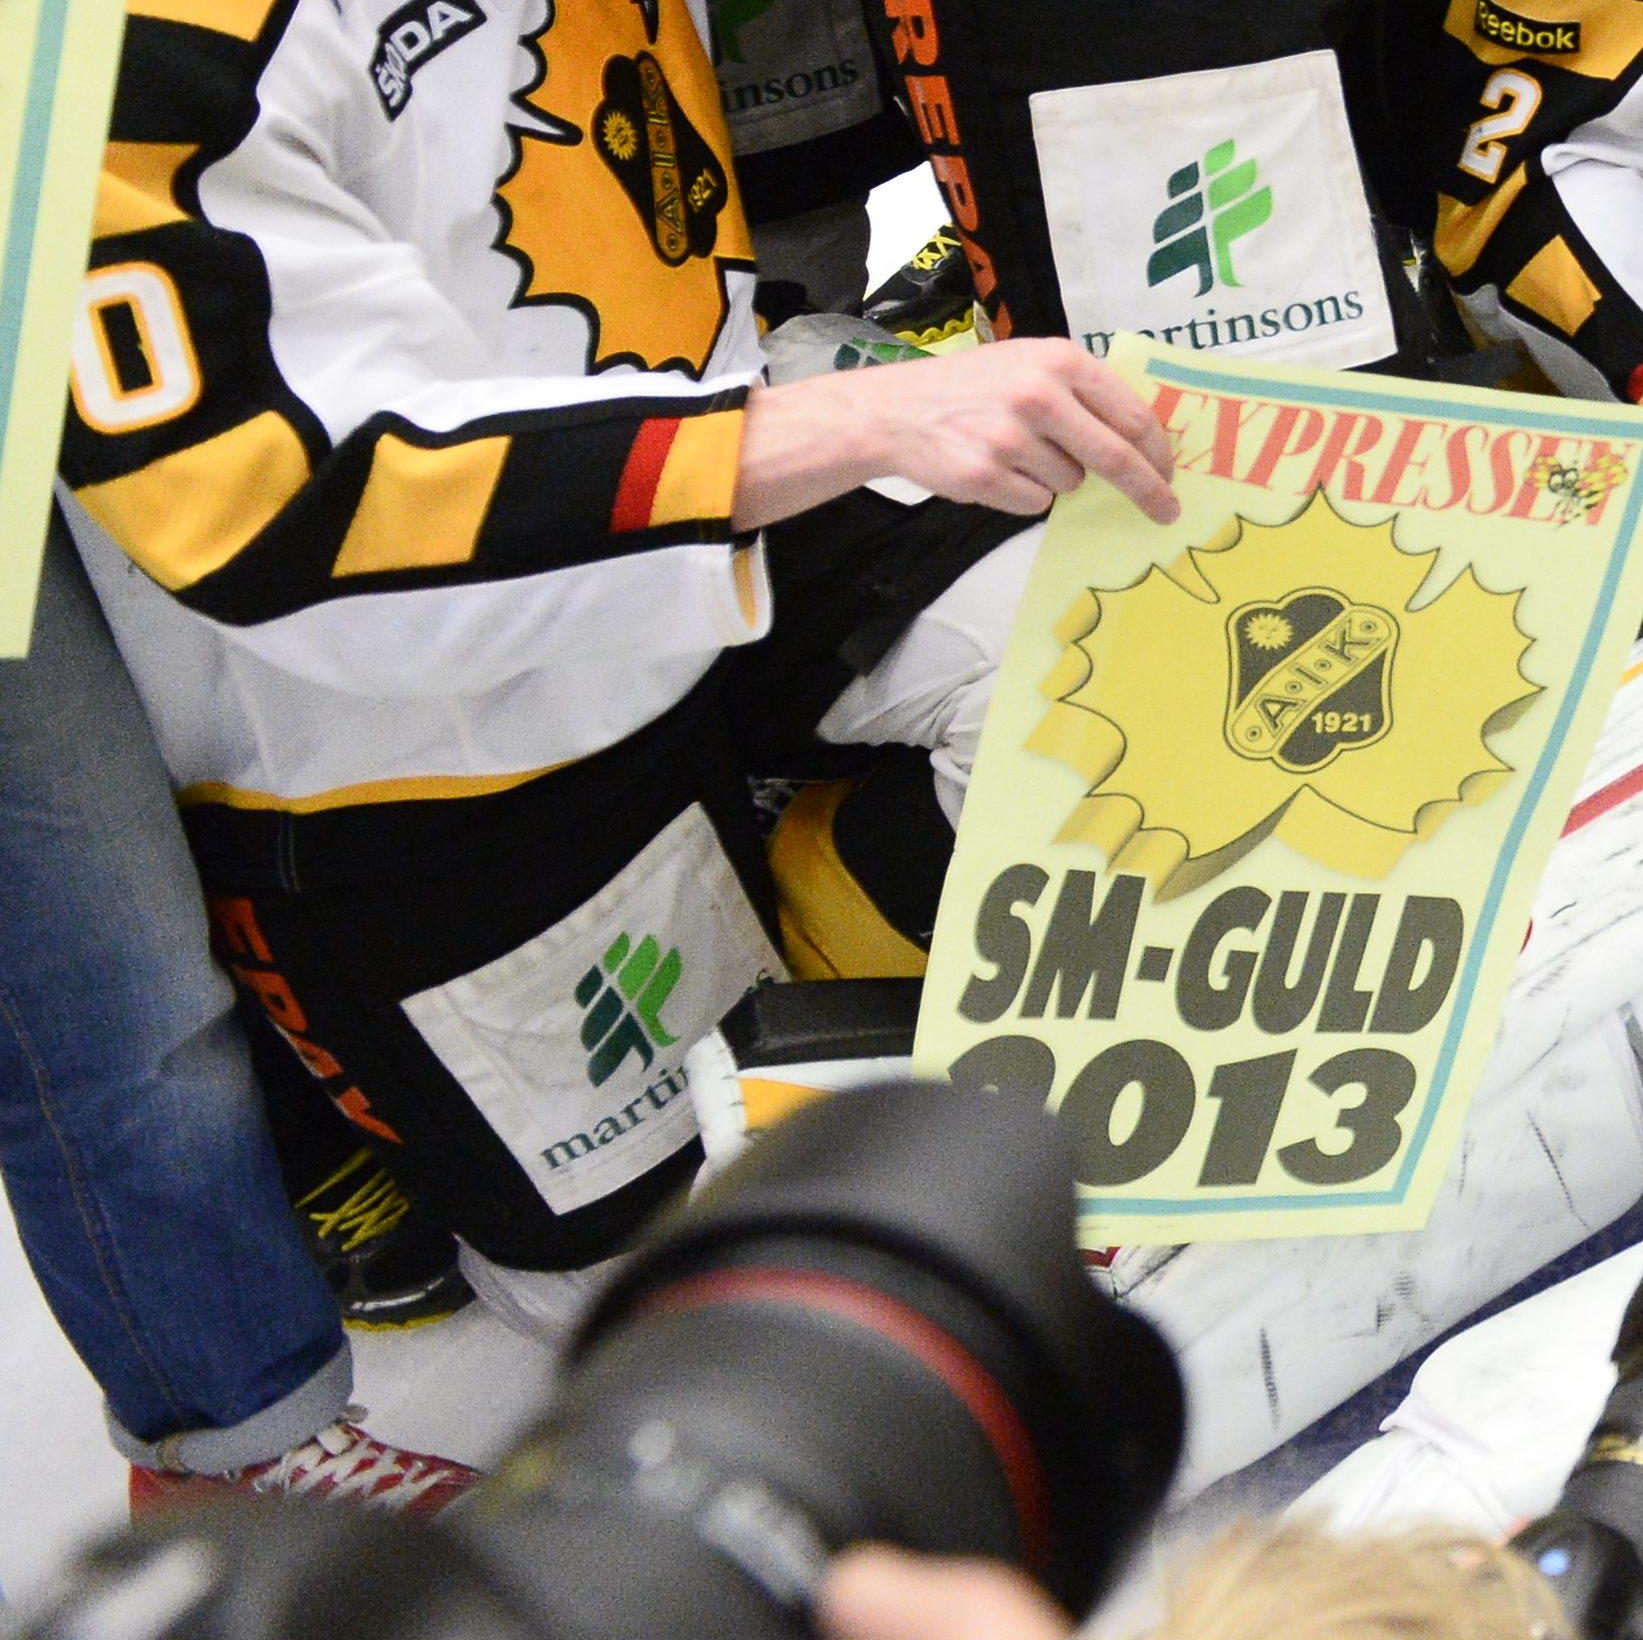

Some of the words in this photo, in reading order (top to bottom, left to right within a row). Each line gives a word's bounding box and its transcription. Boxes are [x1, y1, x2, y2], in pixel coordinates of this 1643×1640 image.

[1456, 67, 1543, 184] 2
[1310, 710, 1374, 736] 1921
[955, 862, 1469, 1036] SM-GULD
